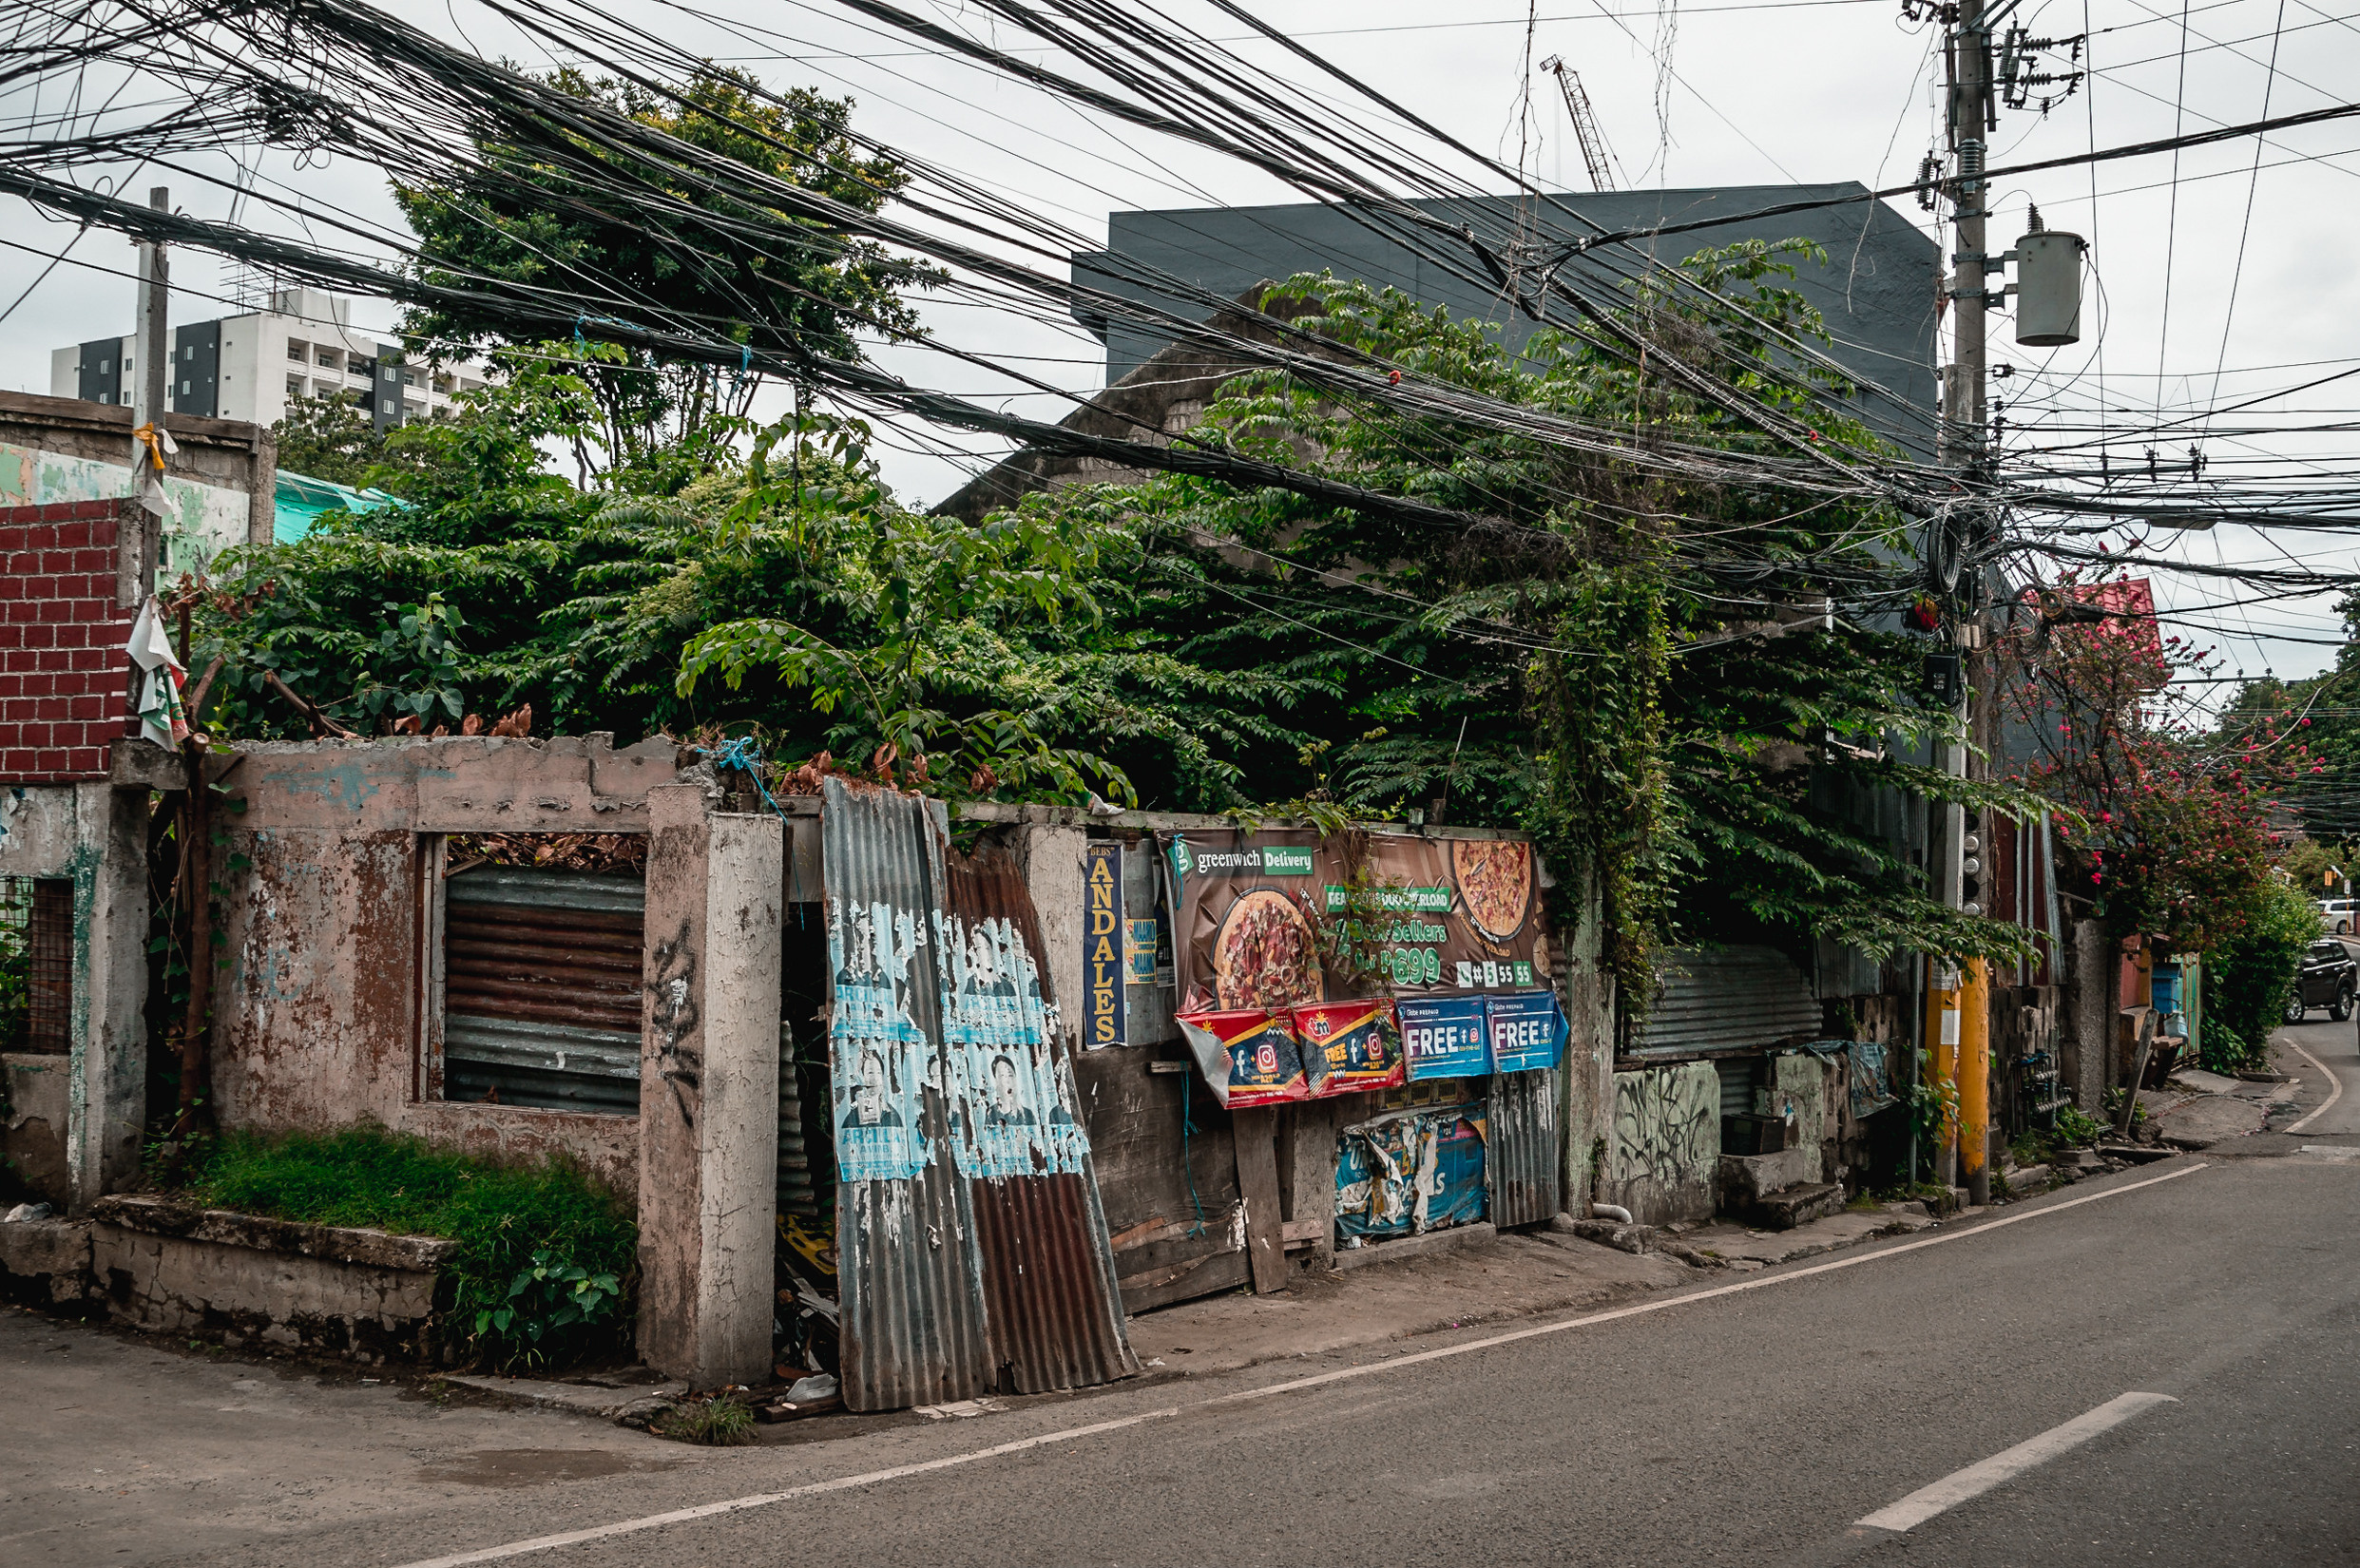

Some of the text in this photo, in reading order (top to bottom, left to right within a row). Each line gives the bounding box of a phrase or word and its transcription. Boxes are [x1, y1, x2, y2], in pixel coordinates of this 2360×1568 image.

[1198, 850, 1312, 874] greenwich Delivery
[1089, 857, 1116, 1042] ANDALES
[1407, 1025, 1459, 1056] FREE
[1495, 1020, 1540, 1049] FREE
[1324, 1042, 1348, 1063] FREE
